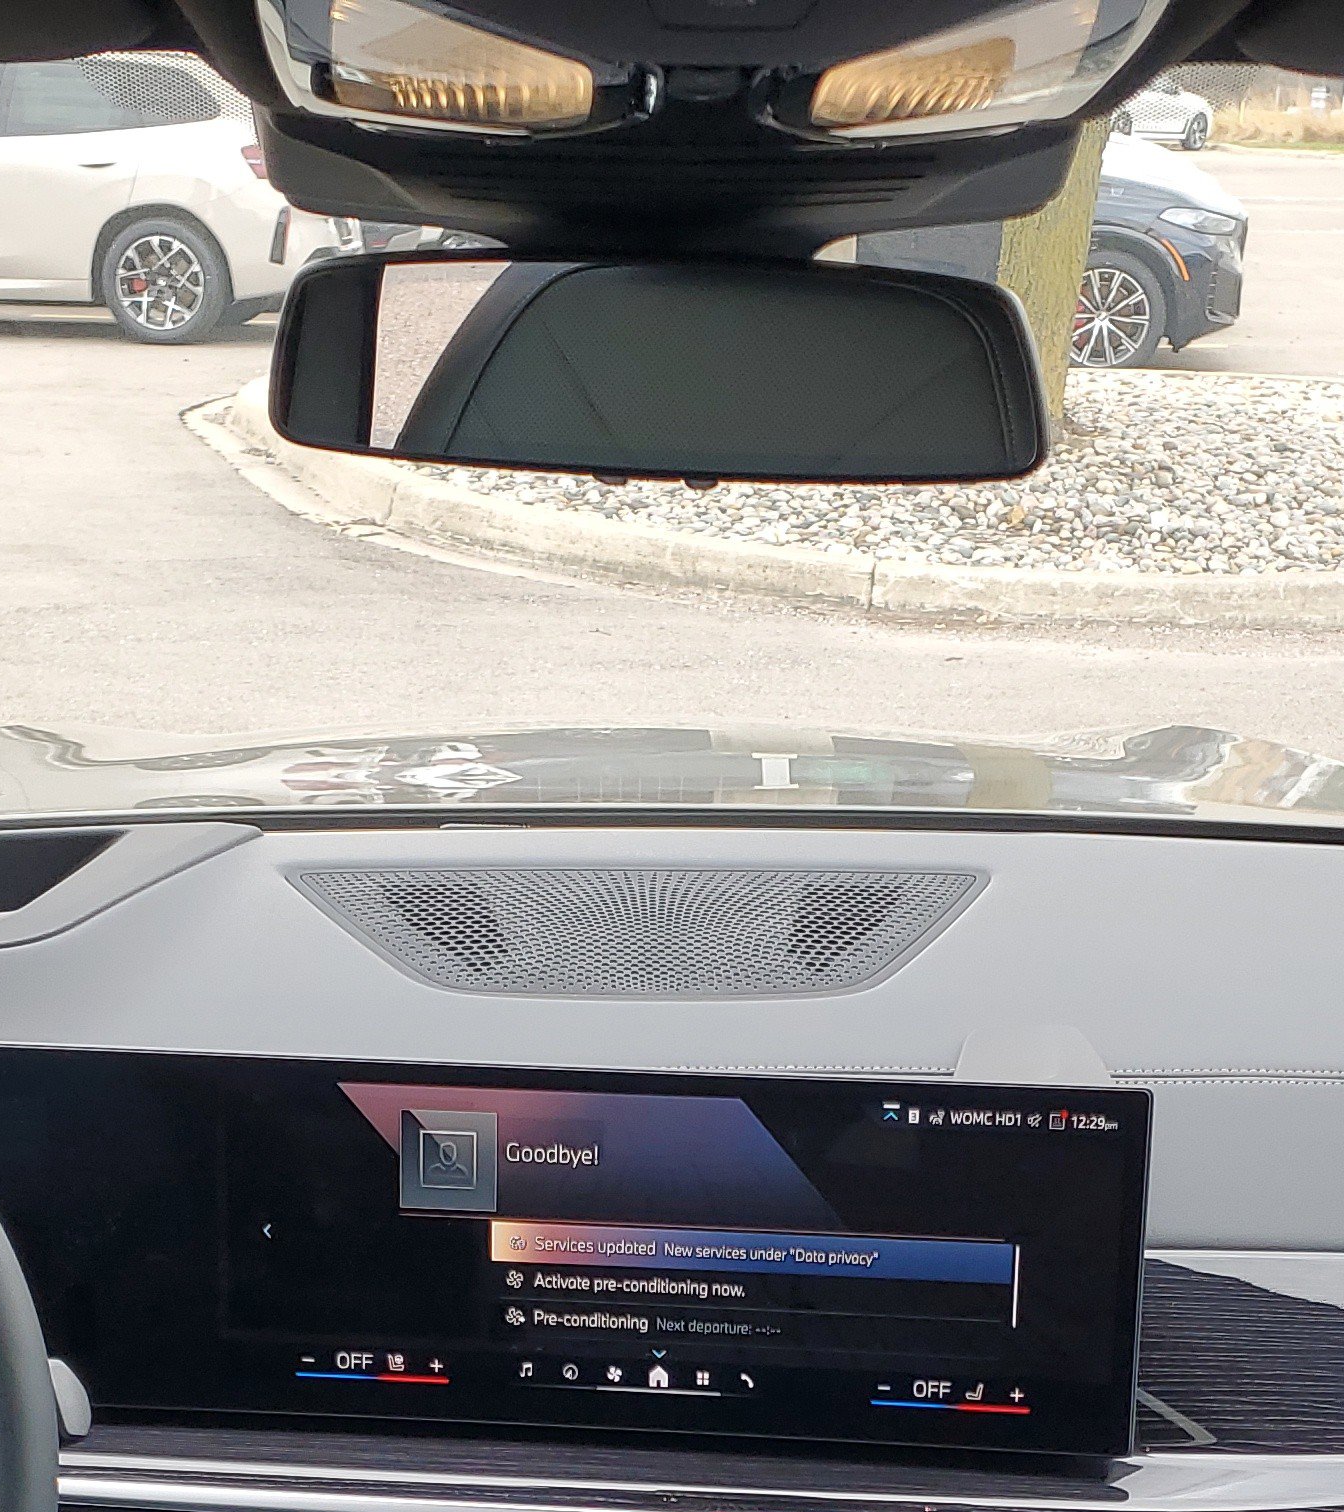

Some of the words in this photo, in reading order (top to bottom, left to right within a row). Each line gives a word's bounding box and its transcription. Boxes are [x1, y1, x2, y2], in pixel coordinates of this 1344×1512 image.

[950, 1110, 993, 1126] WOMC
[995, 1111, 1022, 1127] HD1
[506, 1142, 599, 1169] Goodbye!
[534, 1236, 594, 1253] Services
[598, 1239, 656, 1257] updated
[664, 1242, 693, 1257] New
[695, 1245, 747, 1260] services
[749, 1248, 787, 1262] under
[534, 1272, 590, 1290] Activate
[594, 1276, 709, 1299] pre-conditioning
[712, 1282, 746, 1297] now.
[533, 1308, 649, 1333] Pre-conditioning
[656, 1317, 685, 1332] Next
[688, 1319, 752, 1336] departure:
[337, 1352, 374, 1370] OFF
[913, 1380, 952, 1399] OFF
